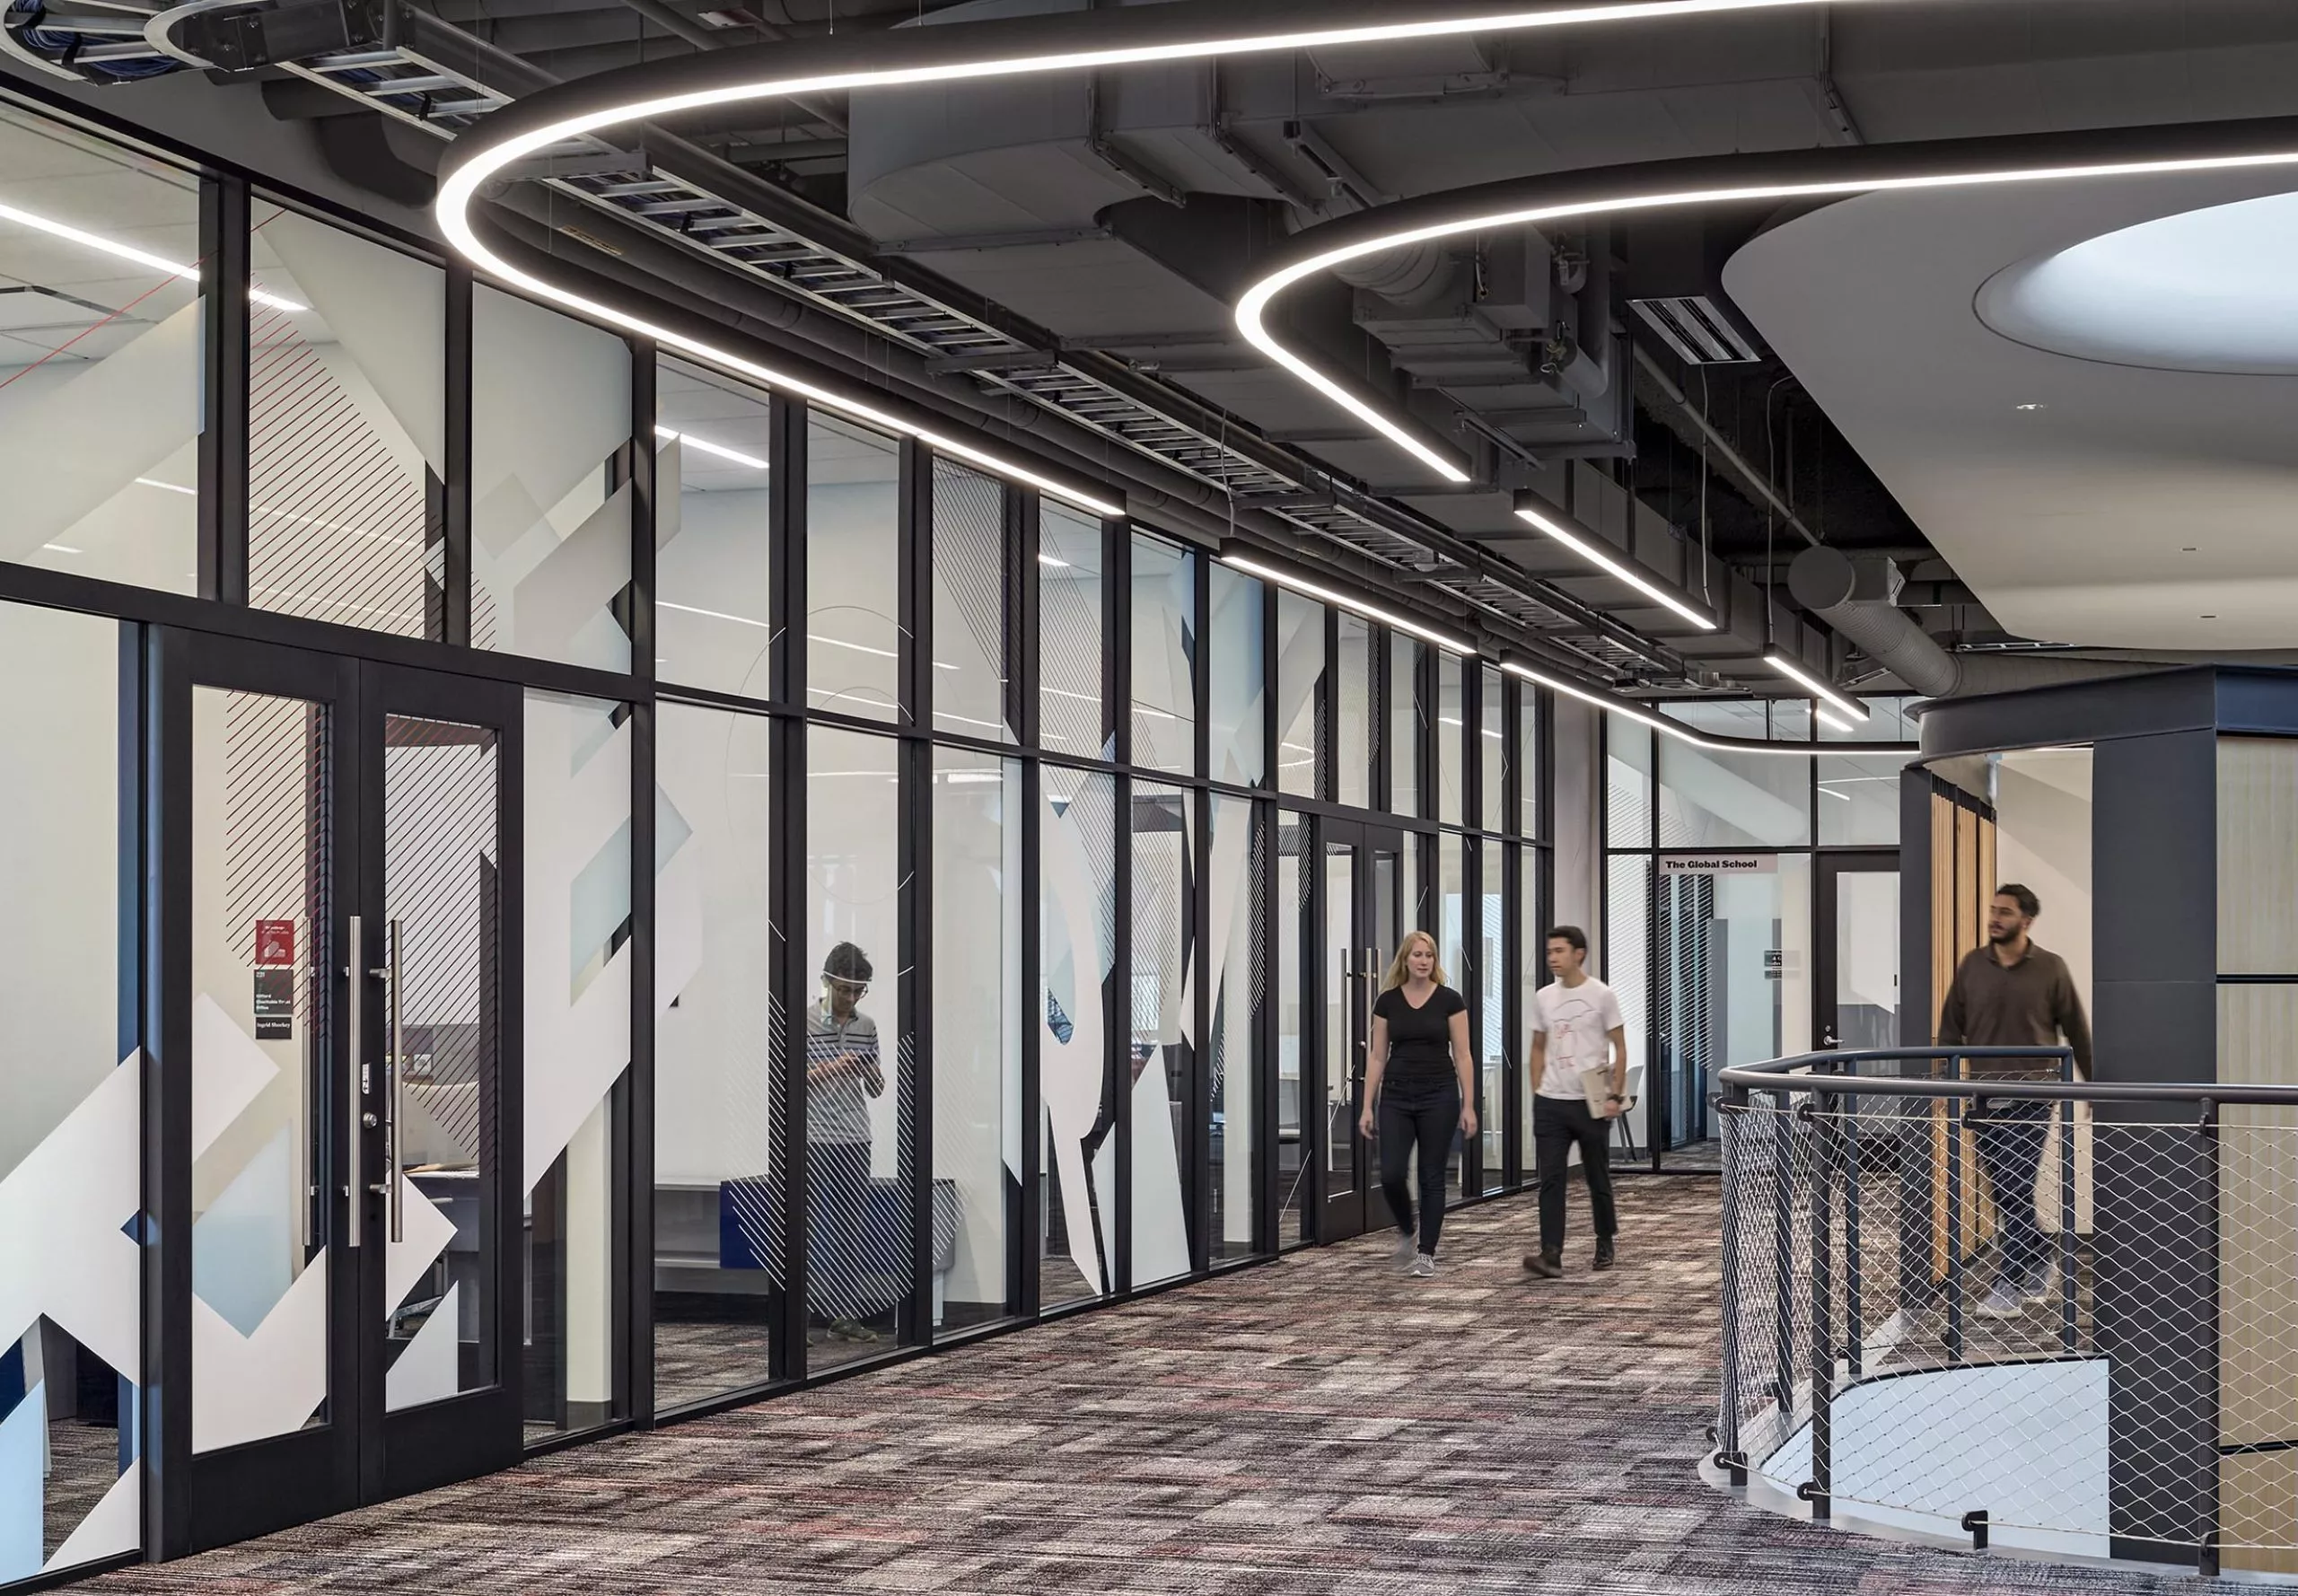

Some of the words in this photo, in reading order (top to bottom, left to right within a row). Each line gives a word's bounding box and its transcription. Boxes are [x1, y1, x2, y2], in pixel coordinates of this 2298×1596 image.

[1665, 860, 1686, 869] The
[1687, 860, 1720, 869] Global
[1722, 860, 1758, 868] School
